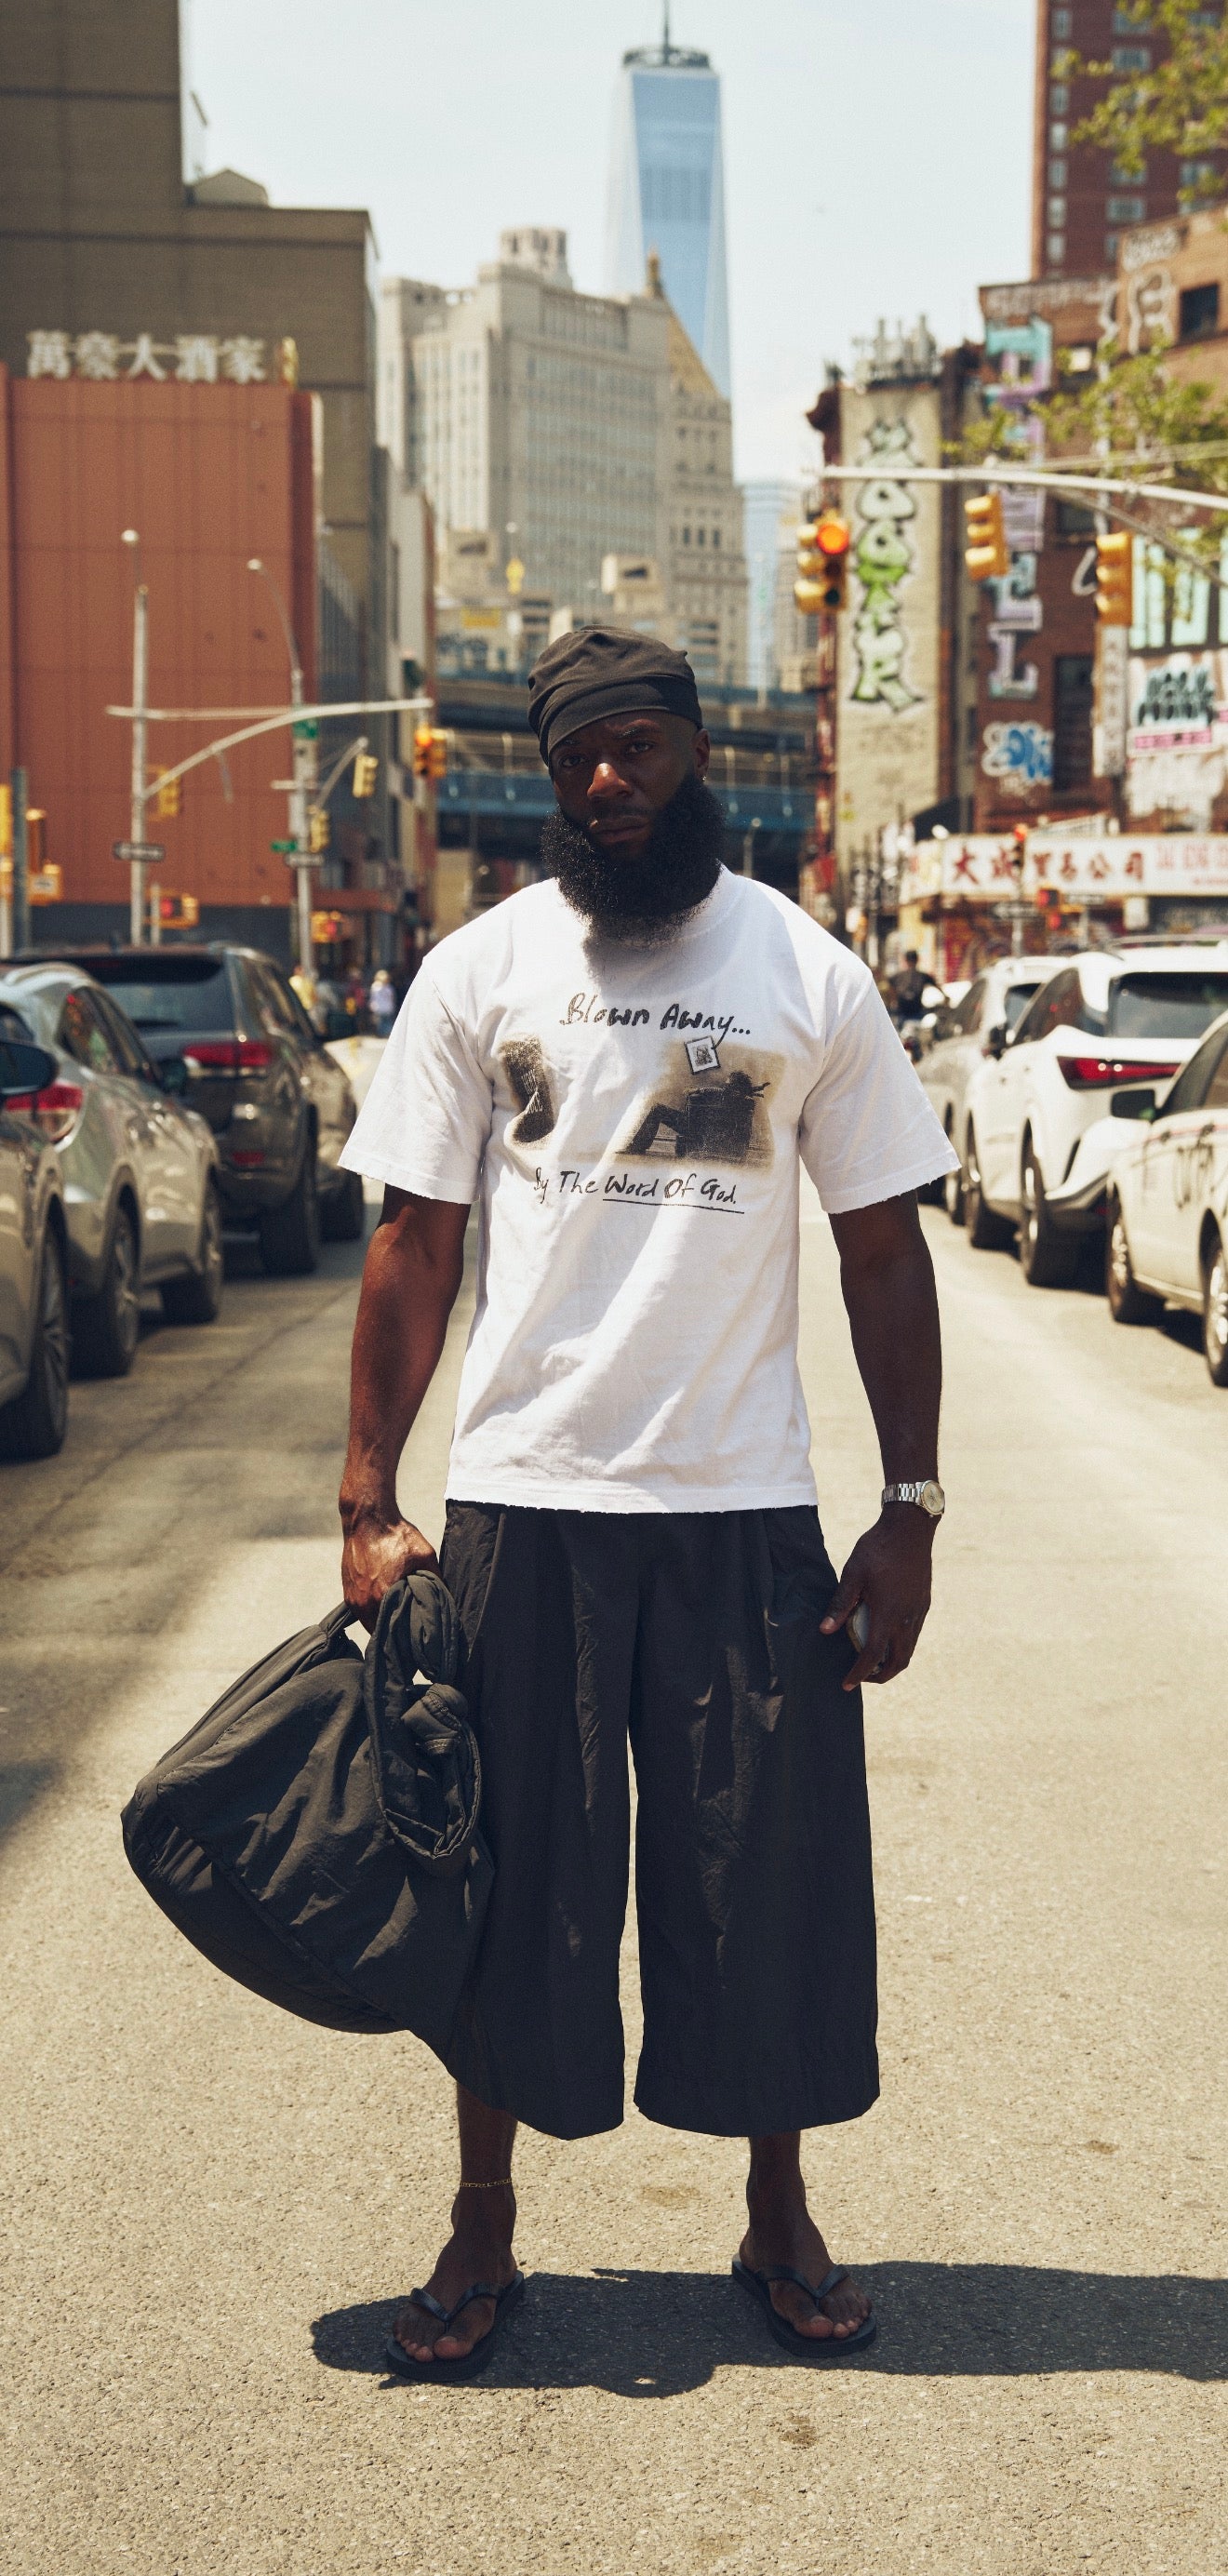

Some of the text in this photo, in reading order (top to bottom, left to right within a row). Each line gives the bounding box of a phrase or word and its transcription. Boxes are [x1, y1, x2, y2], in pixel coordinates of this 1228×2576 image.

[559, 992, 650, 1027] Blown
[533, 1167, 737, 1205] By The Word Of God.
